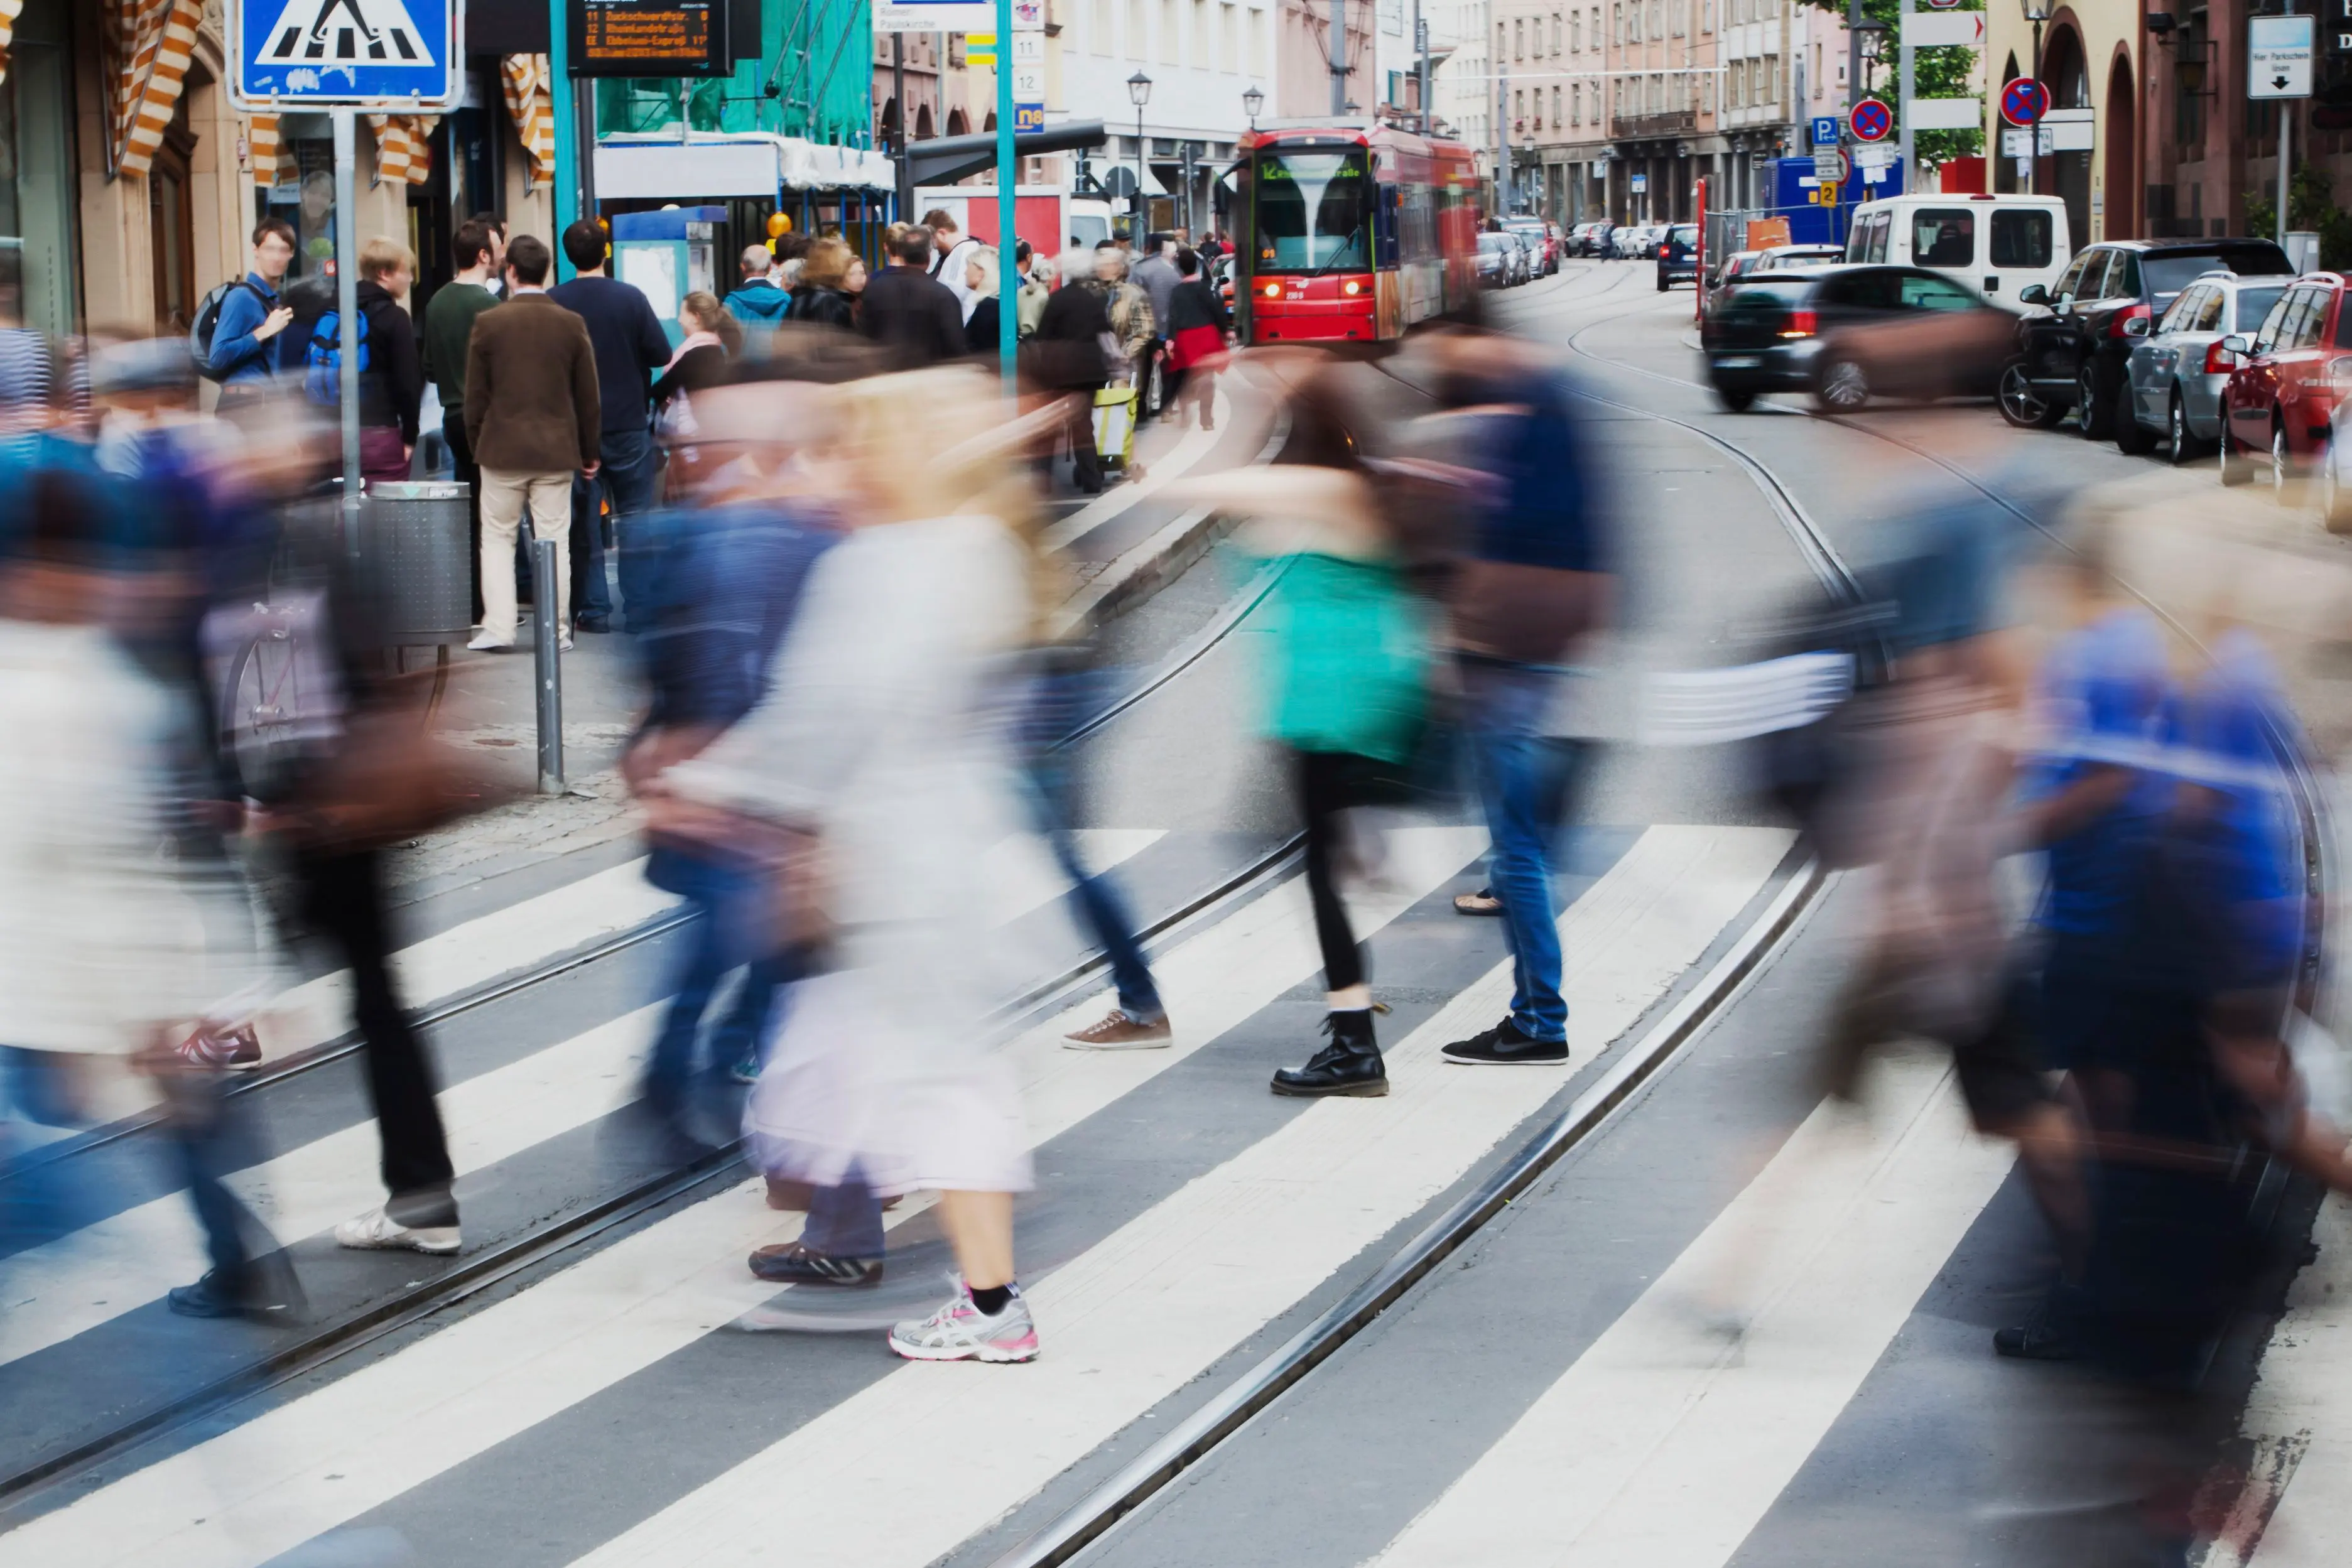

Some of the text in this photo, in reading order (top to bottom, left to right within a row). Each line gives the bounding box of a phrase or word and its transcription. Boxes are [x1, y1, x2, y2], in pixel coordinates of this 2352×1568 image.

[1019, 41, 1033, 54] 11
[1019, 76, 1034, 89] 12
[1019, 109, 1043, 124] n8
[1818, 120, 1832, 141] P
[1824, 187, 1833, 202] 2
